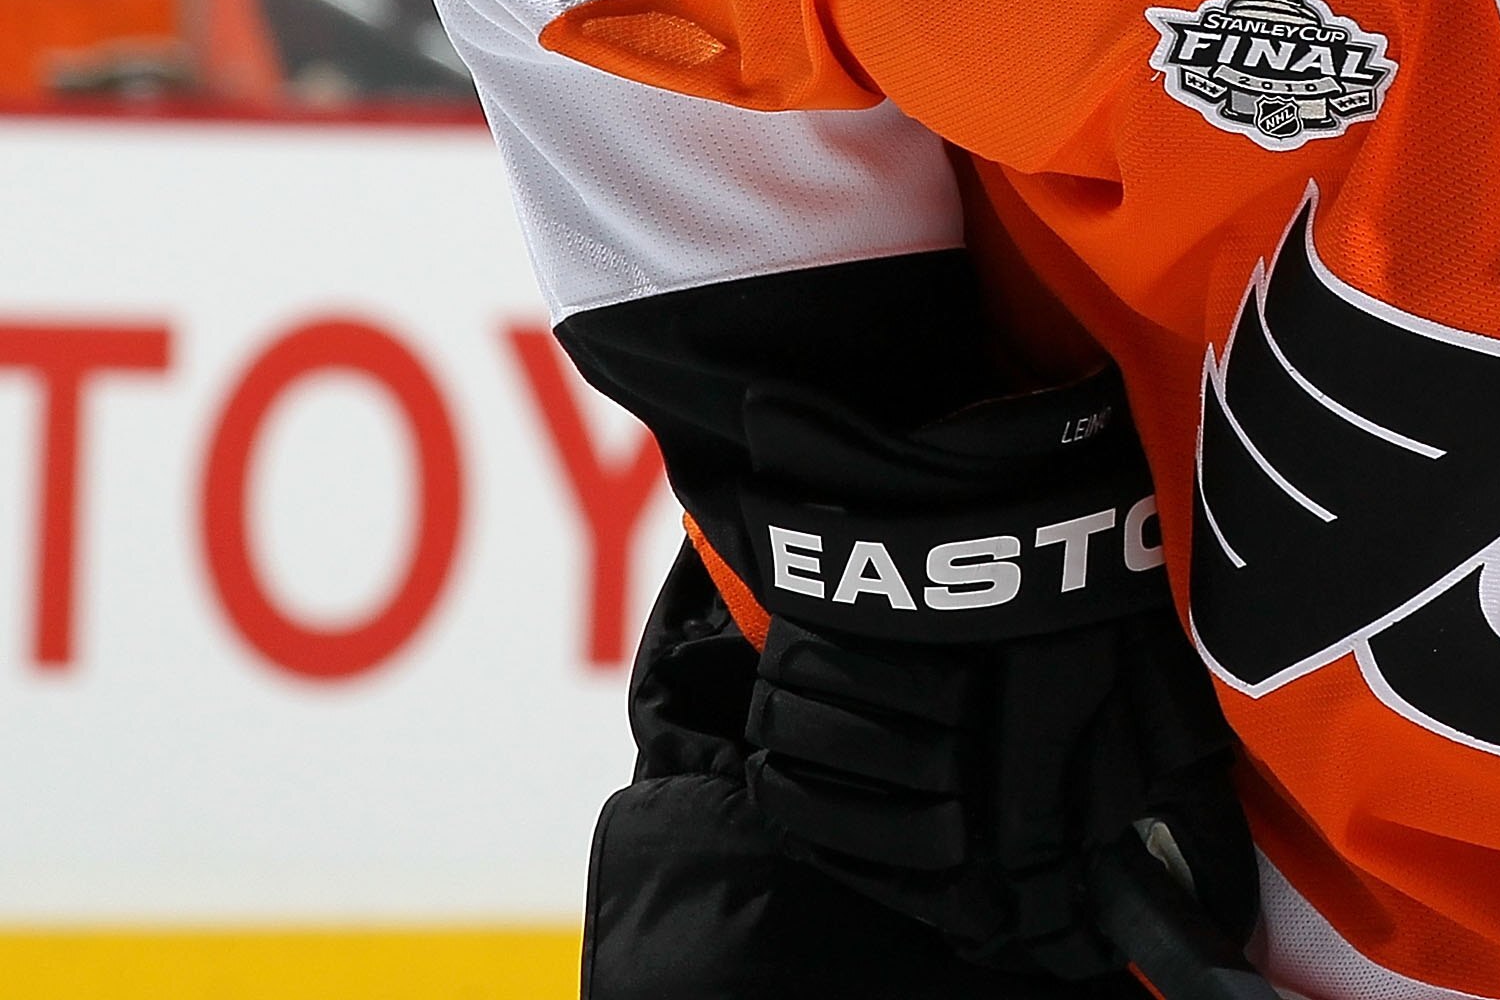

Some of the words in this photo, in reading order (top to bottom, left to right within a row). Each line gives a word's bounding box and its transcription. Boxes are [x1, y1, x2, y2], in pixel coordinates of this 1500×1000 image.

[1177, 29, 1375, 80] FINAL
[1238, 75, 1319, 93] 2010
[1265, 102, 1294, 131] NHL
